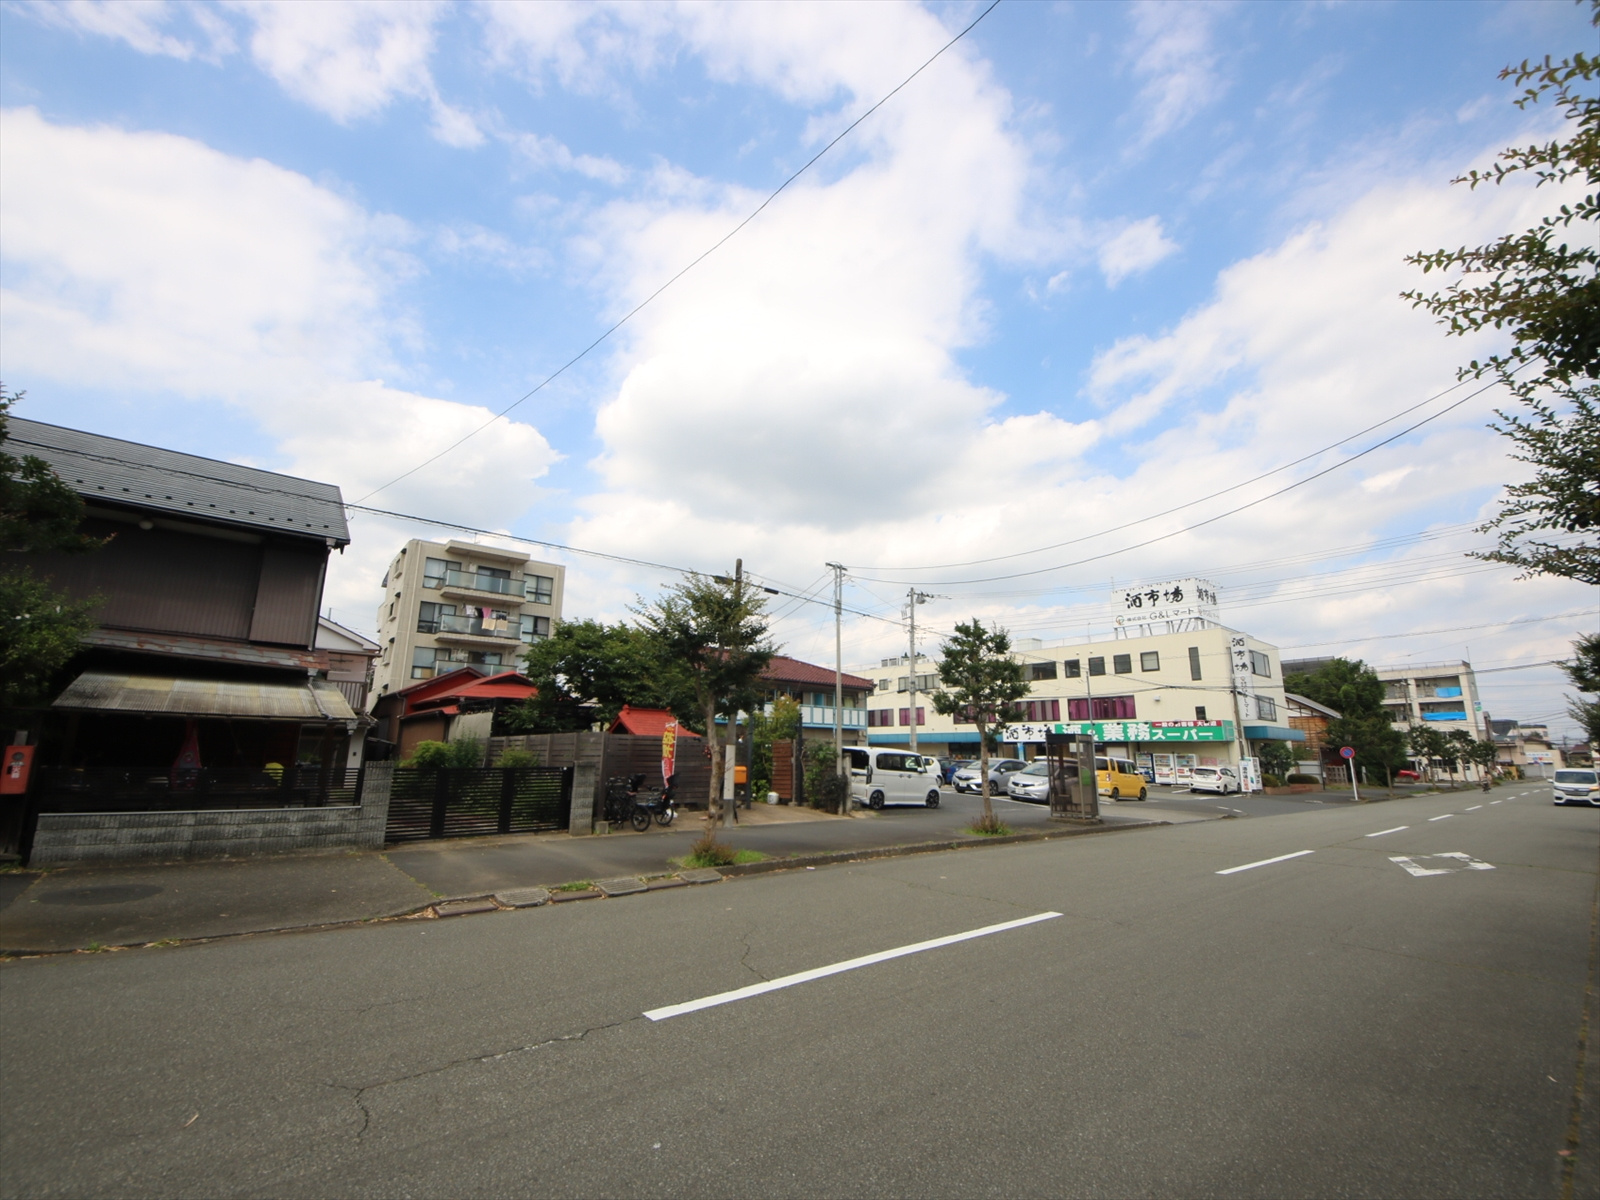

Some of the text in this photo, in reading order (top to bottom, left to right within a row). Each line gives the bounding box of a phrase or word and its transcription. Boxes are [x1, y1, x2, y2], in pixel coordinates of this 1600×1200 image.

[1125, 586, 1184, 609] 酒市場
[1231, 637, 1249, 672] 酒市場
